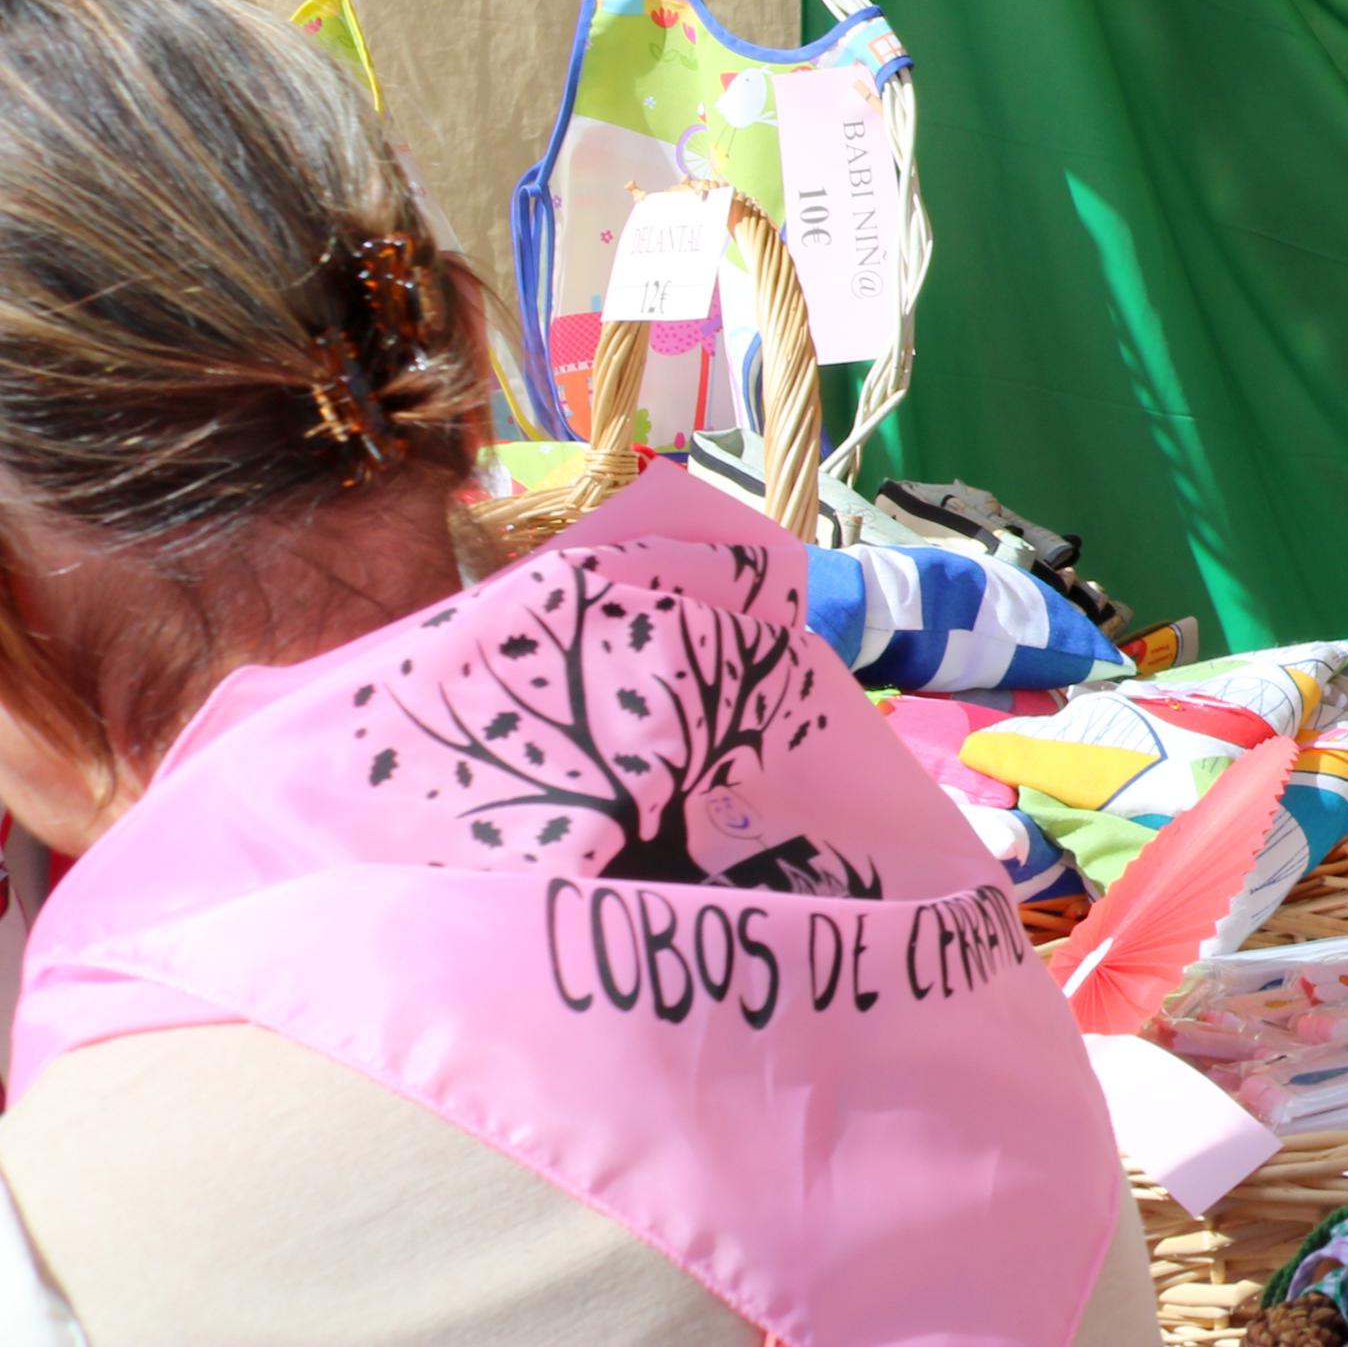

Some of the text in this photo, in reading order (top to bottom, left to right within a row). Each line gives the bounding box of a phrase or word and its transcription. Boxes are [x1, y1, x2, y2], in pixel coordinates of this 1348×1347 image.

[631, 223, 705, 255] DELANTAL
[799, 185, 832, 249] 10€
[842, 120, 887, 301] BABI NIÑ@
[640, 280, 672, 315] 12€
[546, 877, 779, 1030] COBOS
[809, 912, 880, 1013] DE
